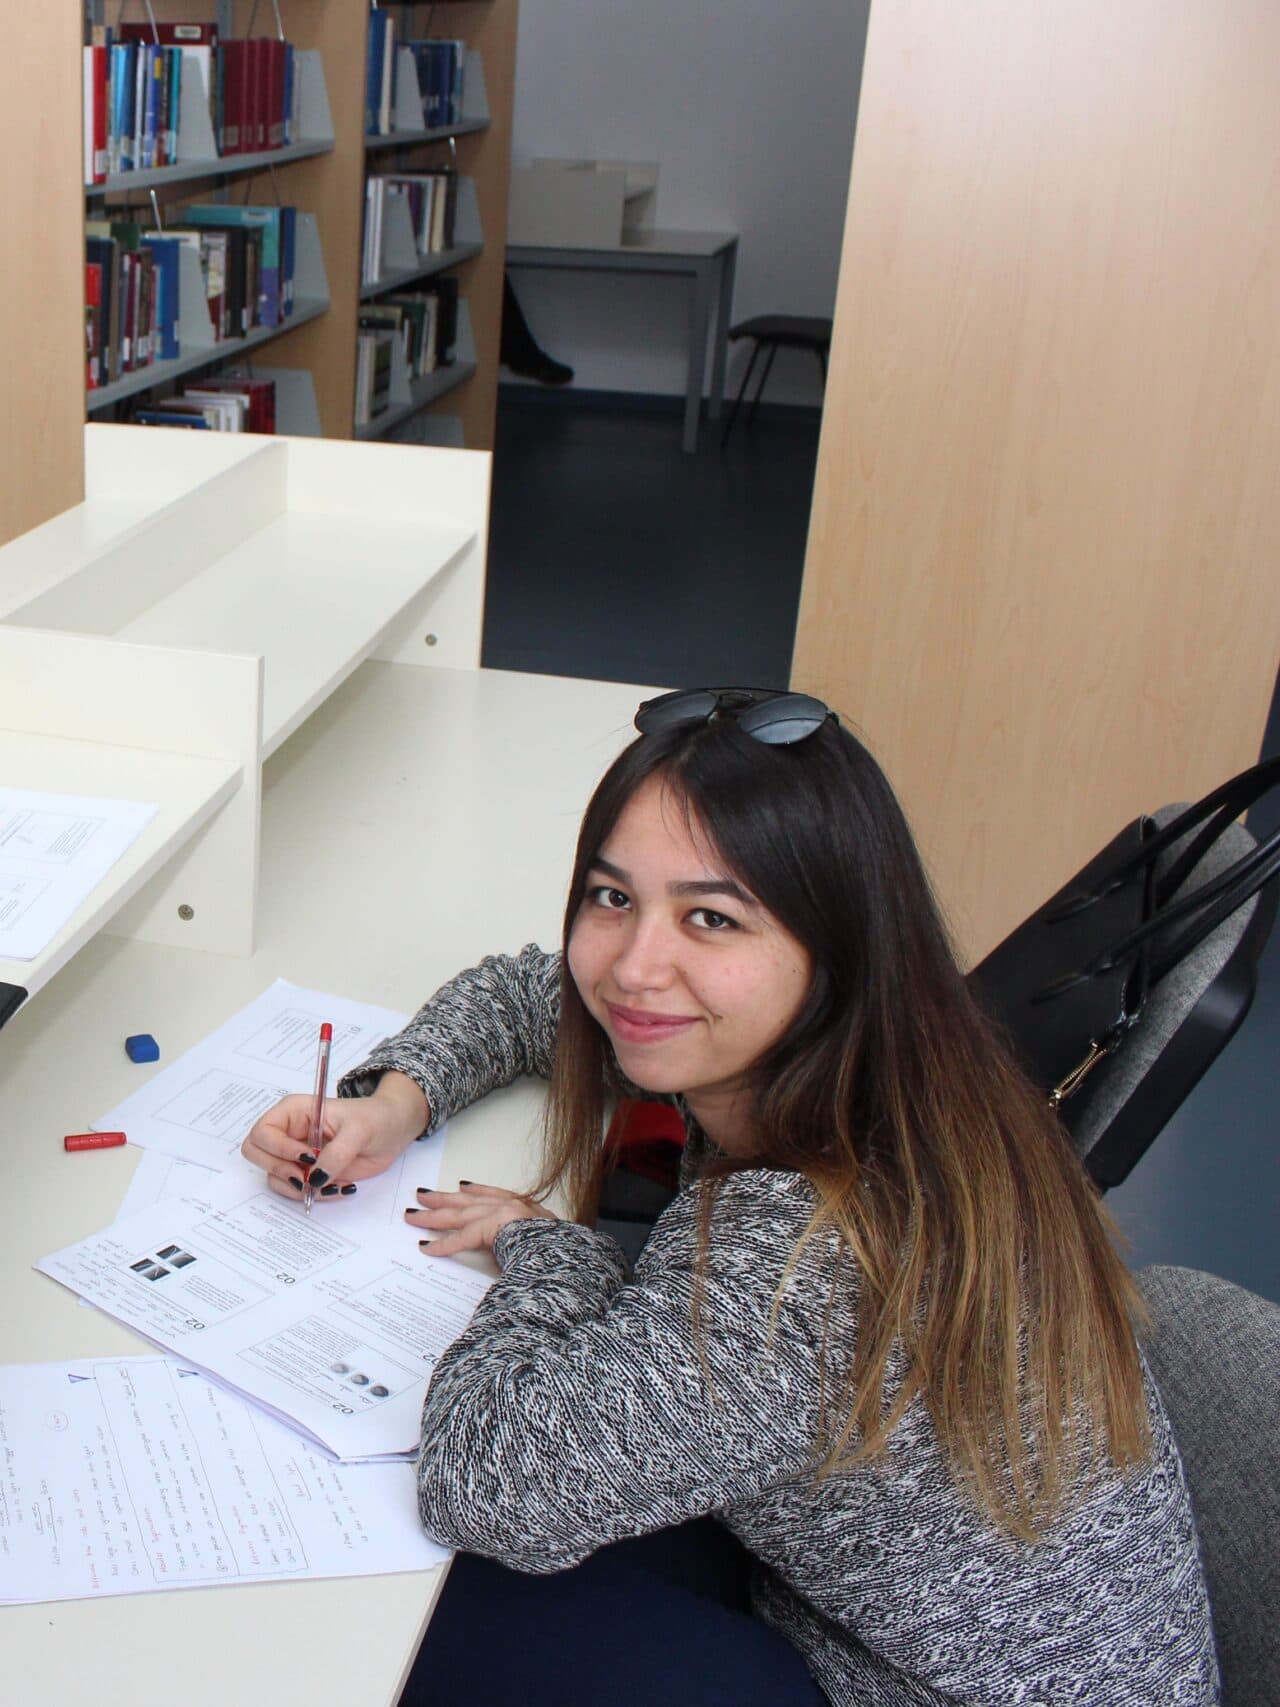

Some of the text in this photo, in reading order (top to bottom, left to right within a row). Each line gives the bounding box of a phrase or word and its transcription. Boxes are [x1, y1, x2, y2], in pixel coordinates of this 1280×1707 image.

[276, 1271, 296, 1285] 02
[185, 1318, 206, 1330] 02
[332, 1402, 355, 1415] 02
